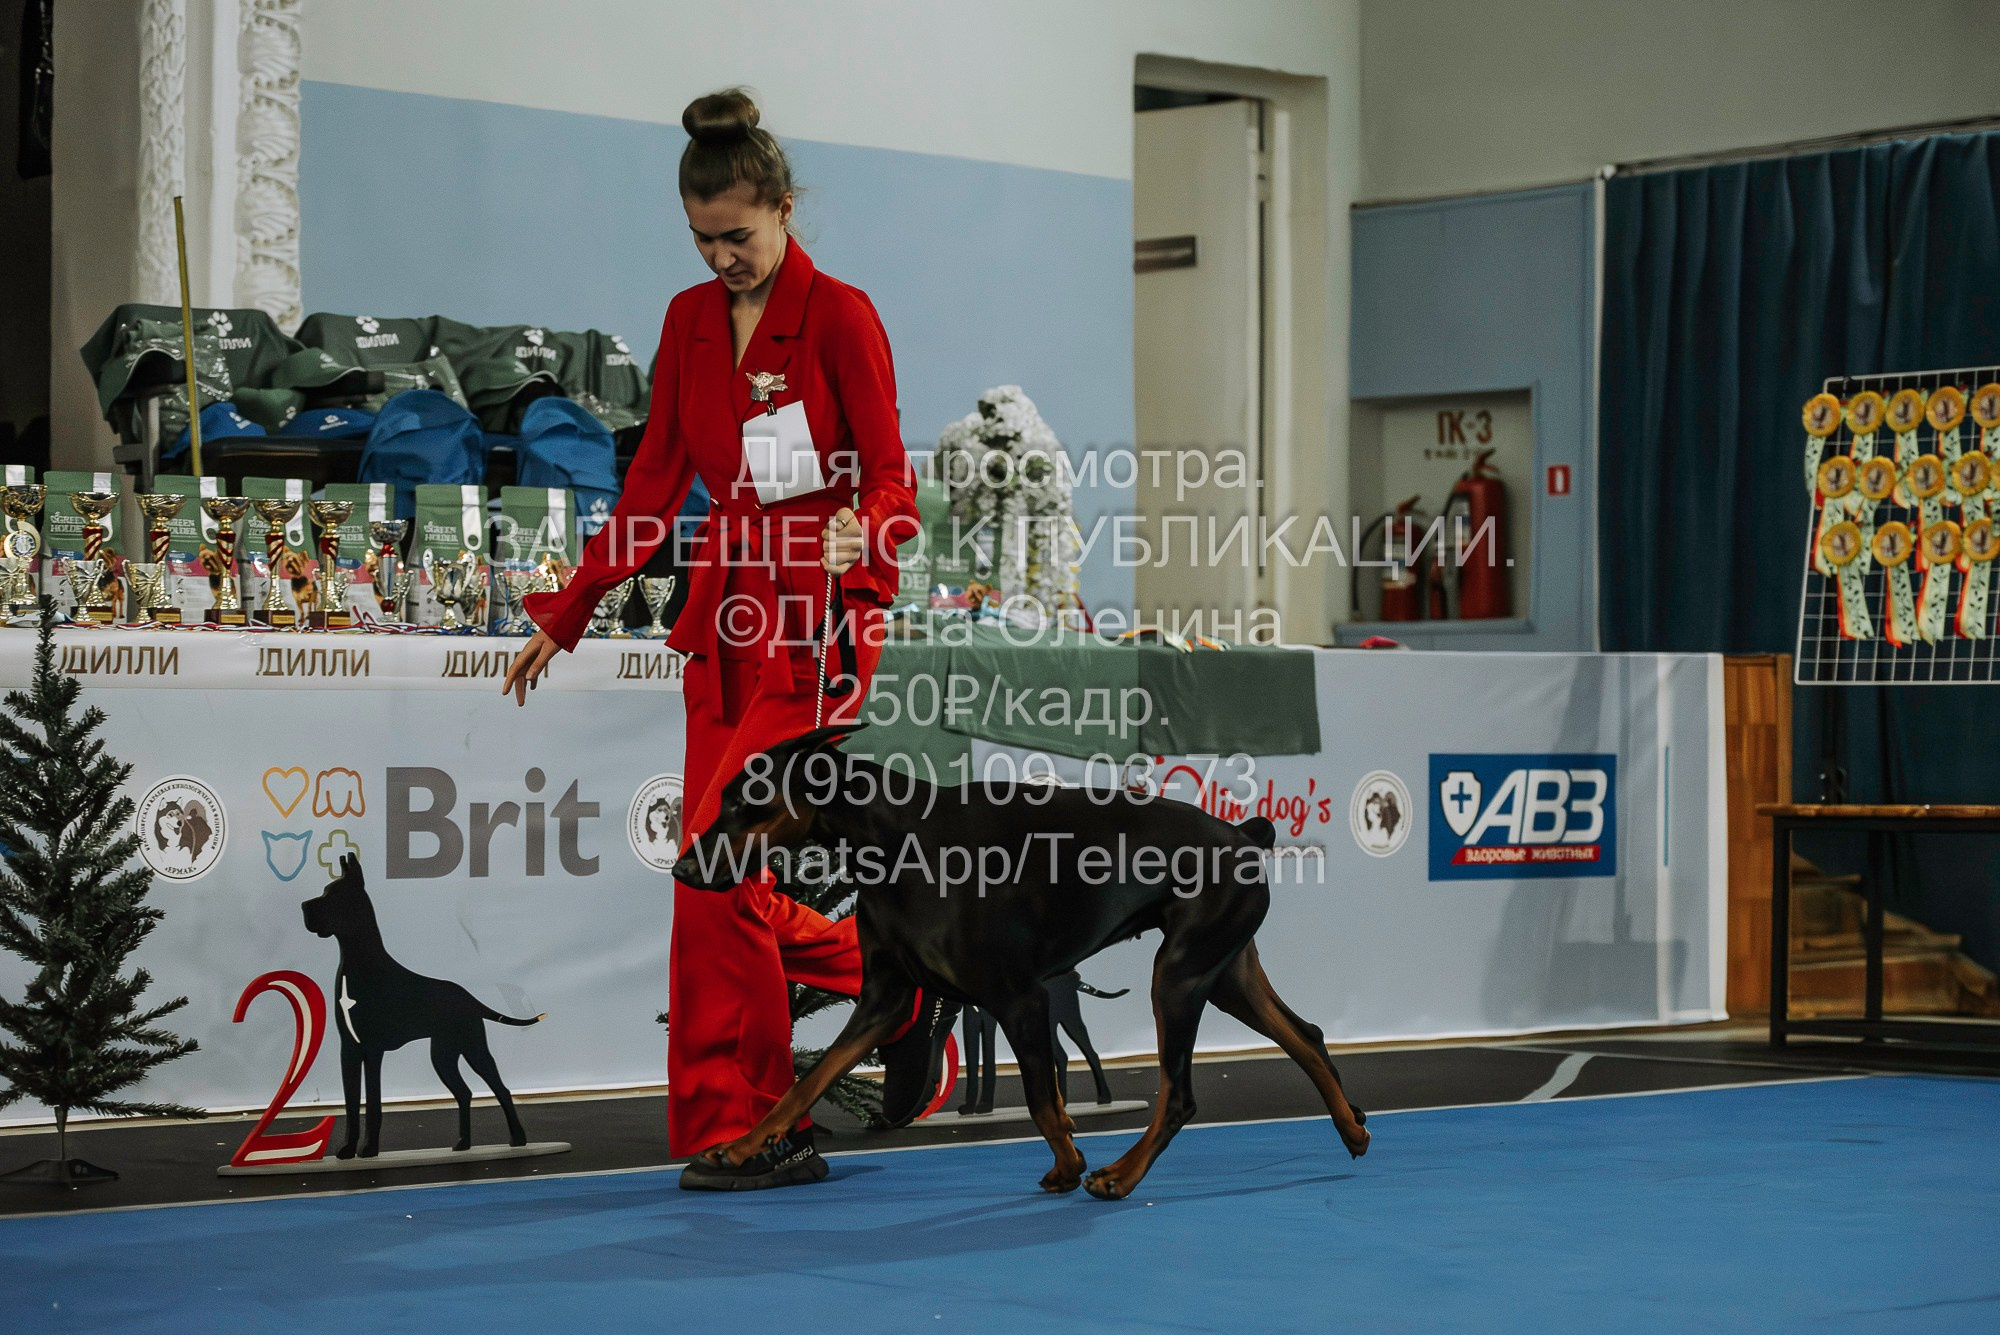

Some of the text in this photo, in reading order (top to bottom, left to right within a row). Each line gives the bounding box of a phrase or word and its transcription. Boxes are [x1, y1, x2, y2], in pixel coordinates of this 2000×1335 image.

[385, 767, 600, 879] Brit
[1256, 777, 1332, 838] dog's
[1464, 769, 1607, 845] АВЗ
